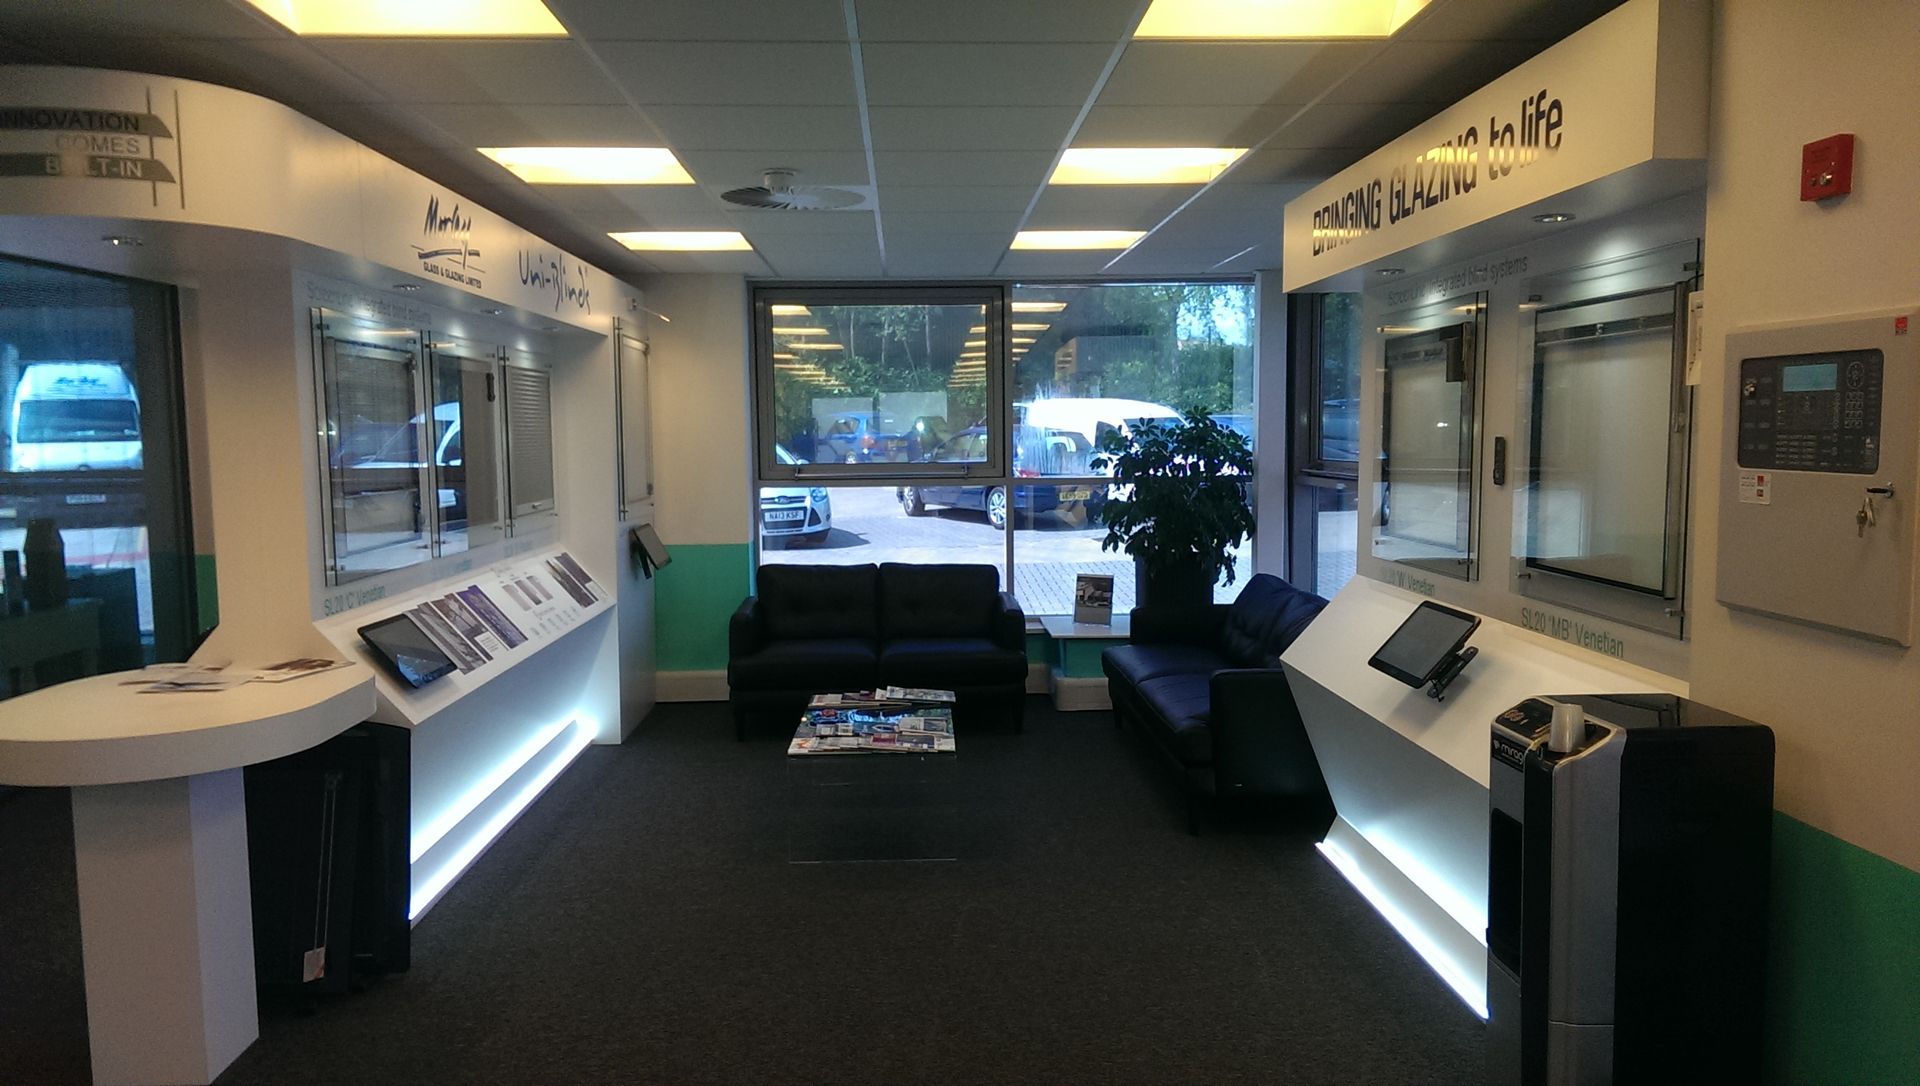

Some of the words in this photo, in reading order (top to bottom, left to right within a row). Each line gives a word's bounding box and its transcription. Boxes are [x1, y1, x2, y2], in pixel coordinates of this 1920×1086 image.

[1313, 177, 1382, 257] BRINGING
[1389, 126, 1479, 225] GLAZING
[1488, 116, 1515, 181] to
[1519, 88, 1564, 169] life
[1521, 607, 1546, 633] SL20
[1575, 622, 1624, 659] Venetian
